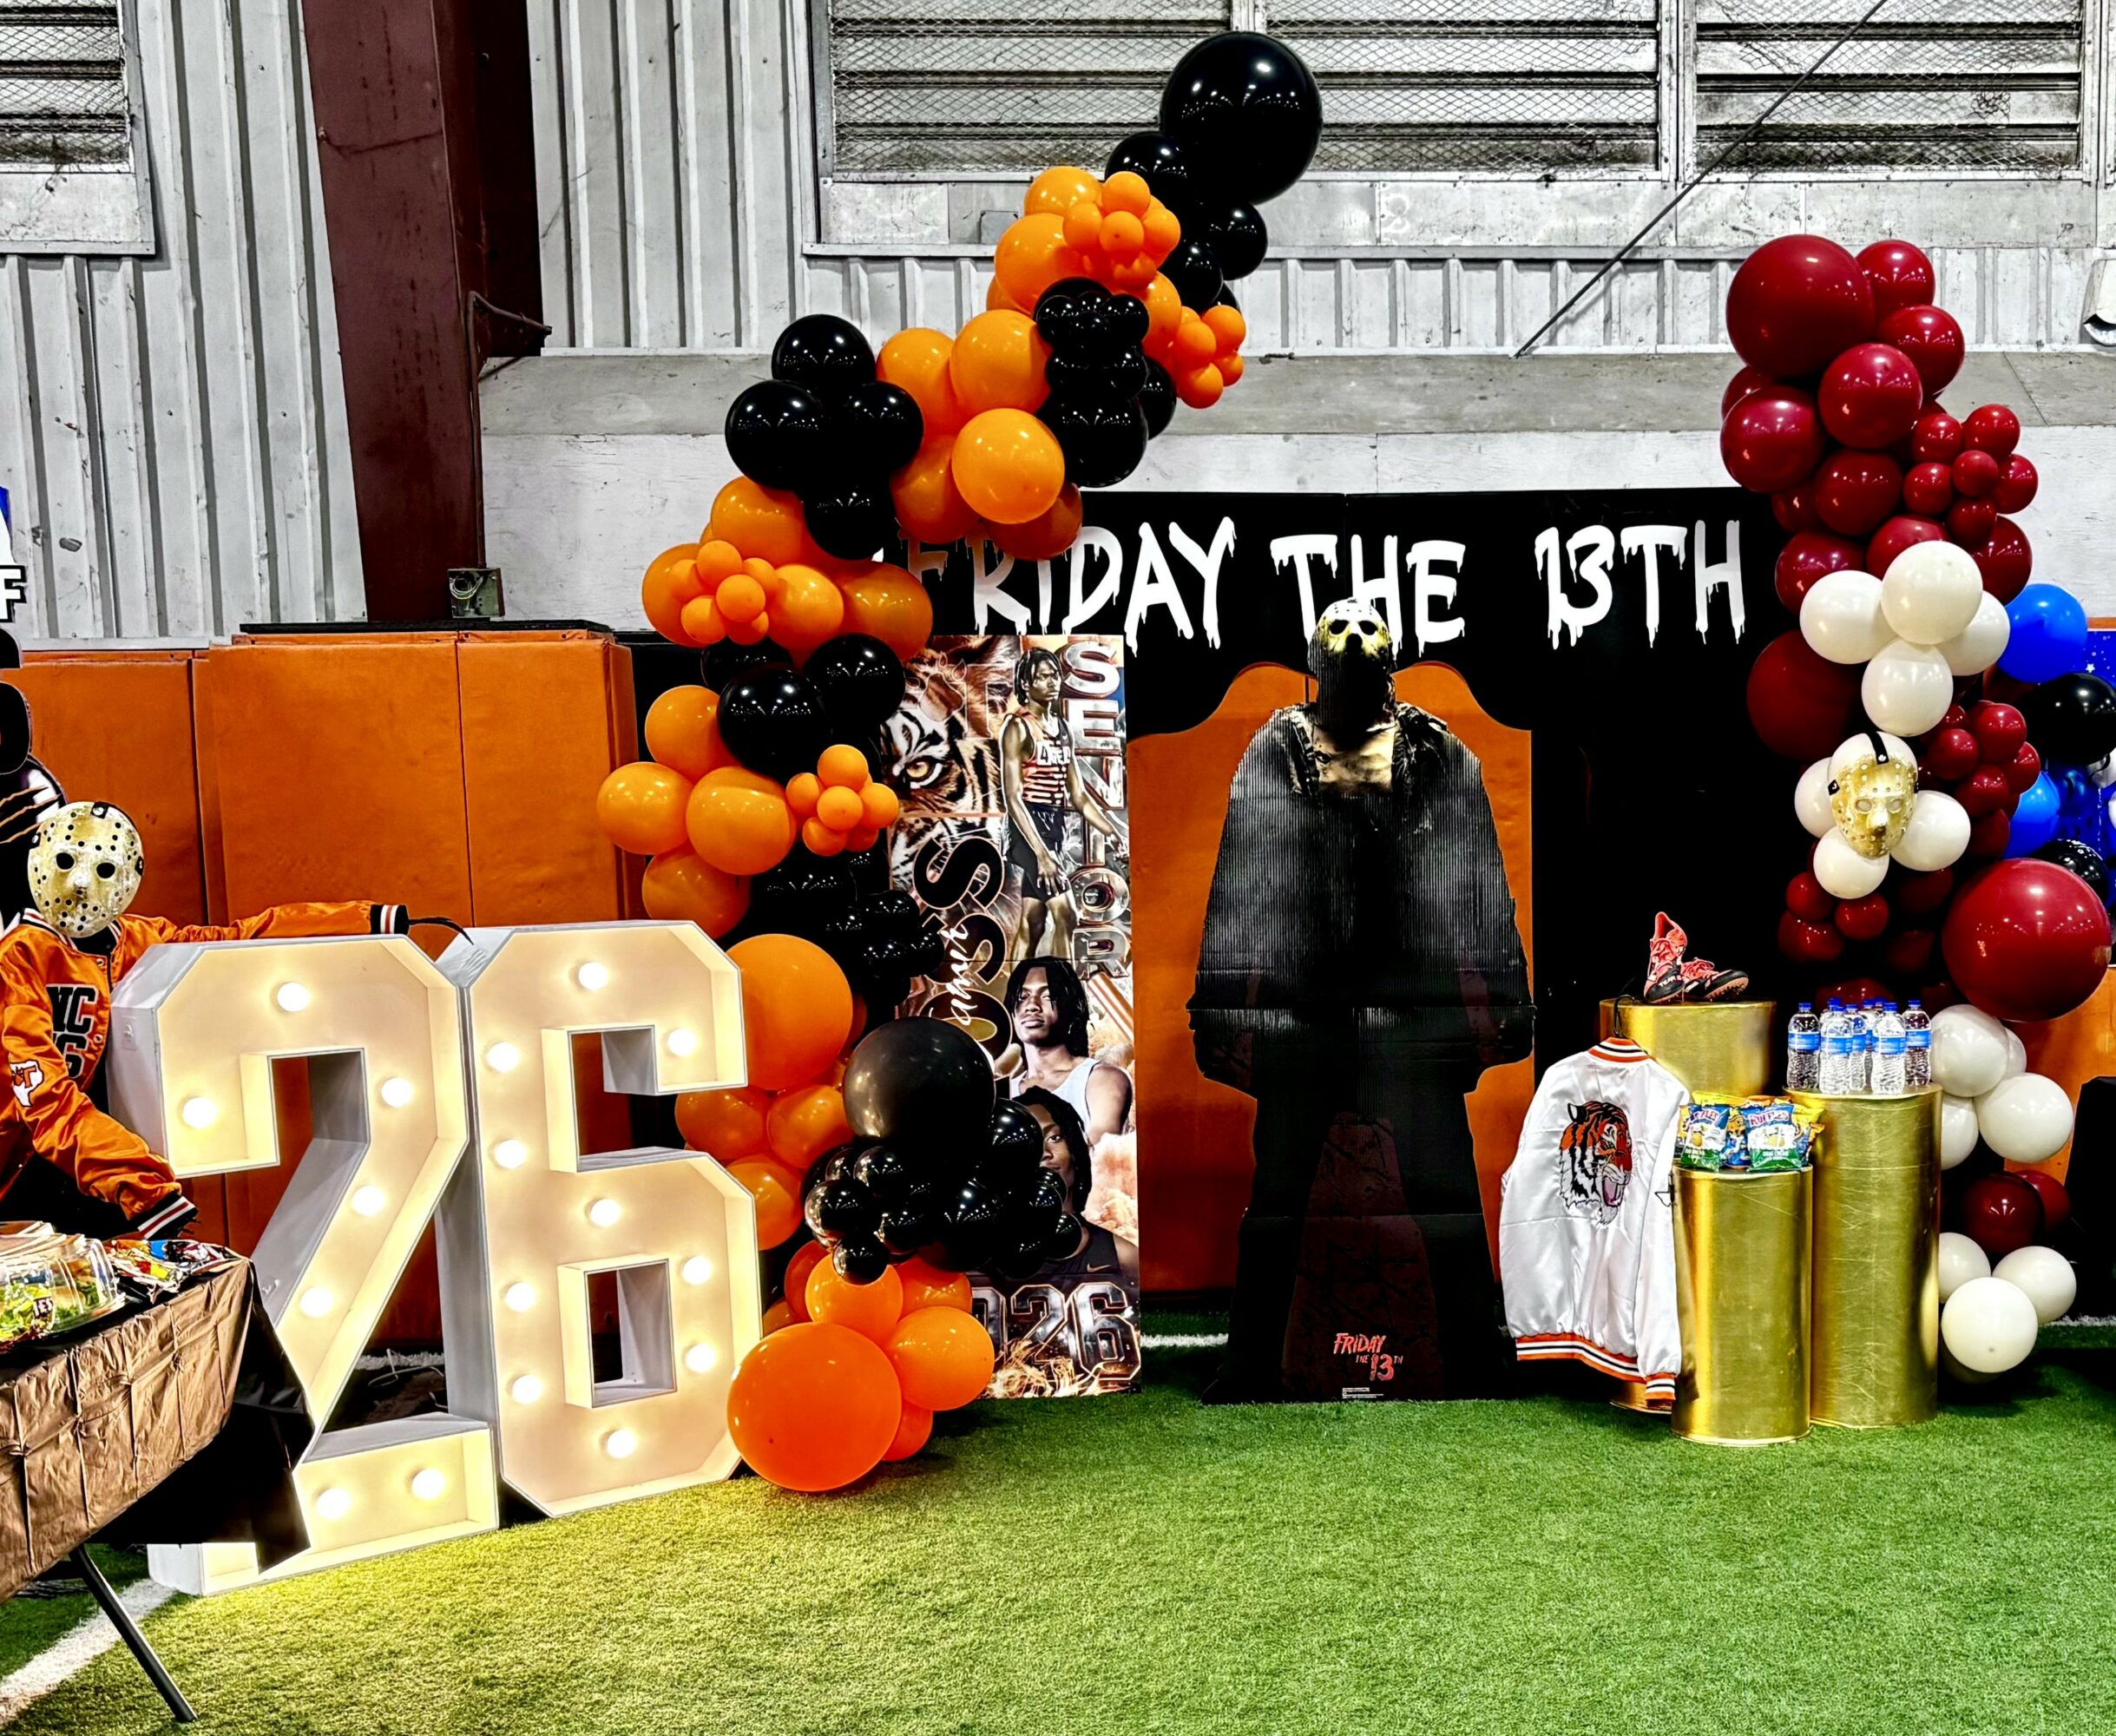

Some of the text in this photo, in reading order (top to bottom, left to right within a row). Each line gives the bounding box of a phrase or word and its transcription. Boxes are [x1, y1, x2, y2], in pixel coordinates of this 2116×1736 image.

[899, 517, 1745, 661] FRIDAY THE 13TH
[1061, 641, 1130, 981] SENIOR
[104, 920, 762, 1595] 26
[1333, 1332, 1387, 1354] FRIDAY
